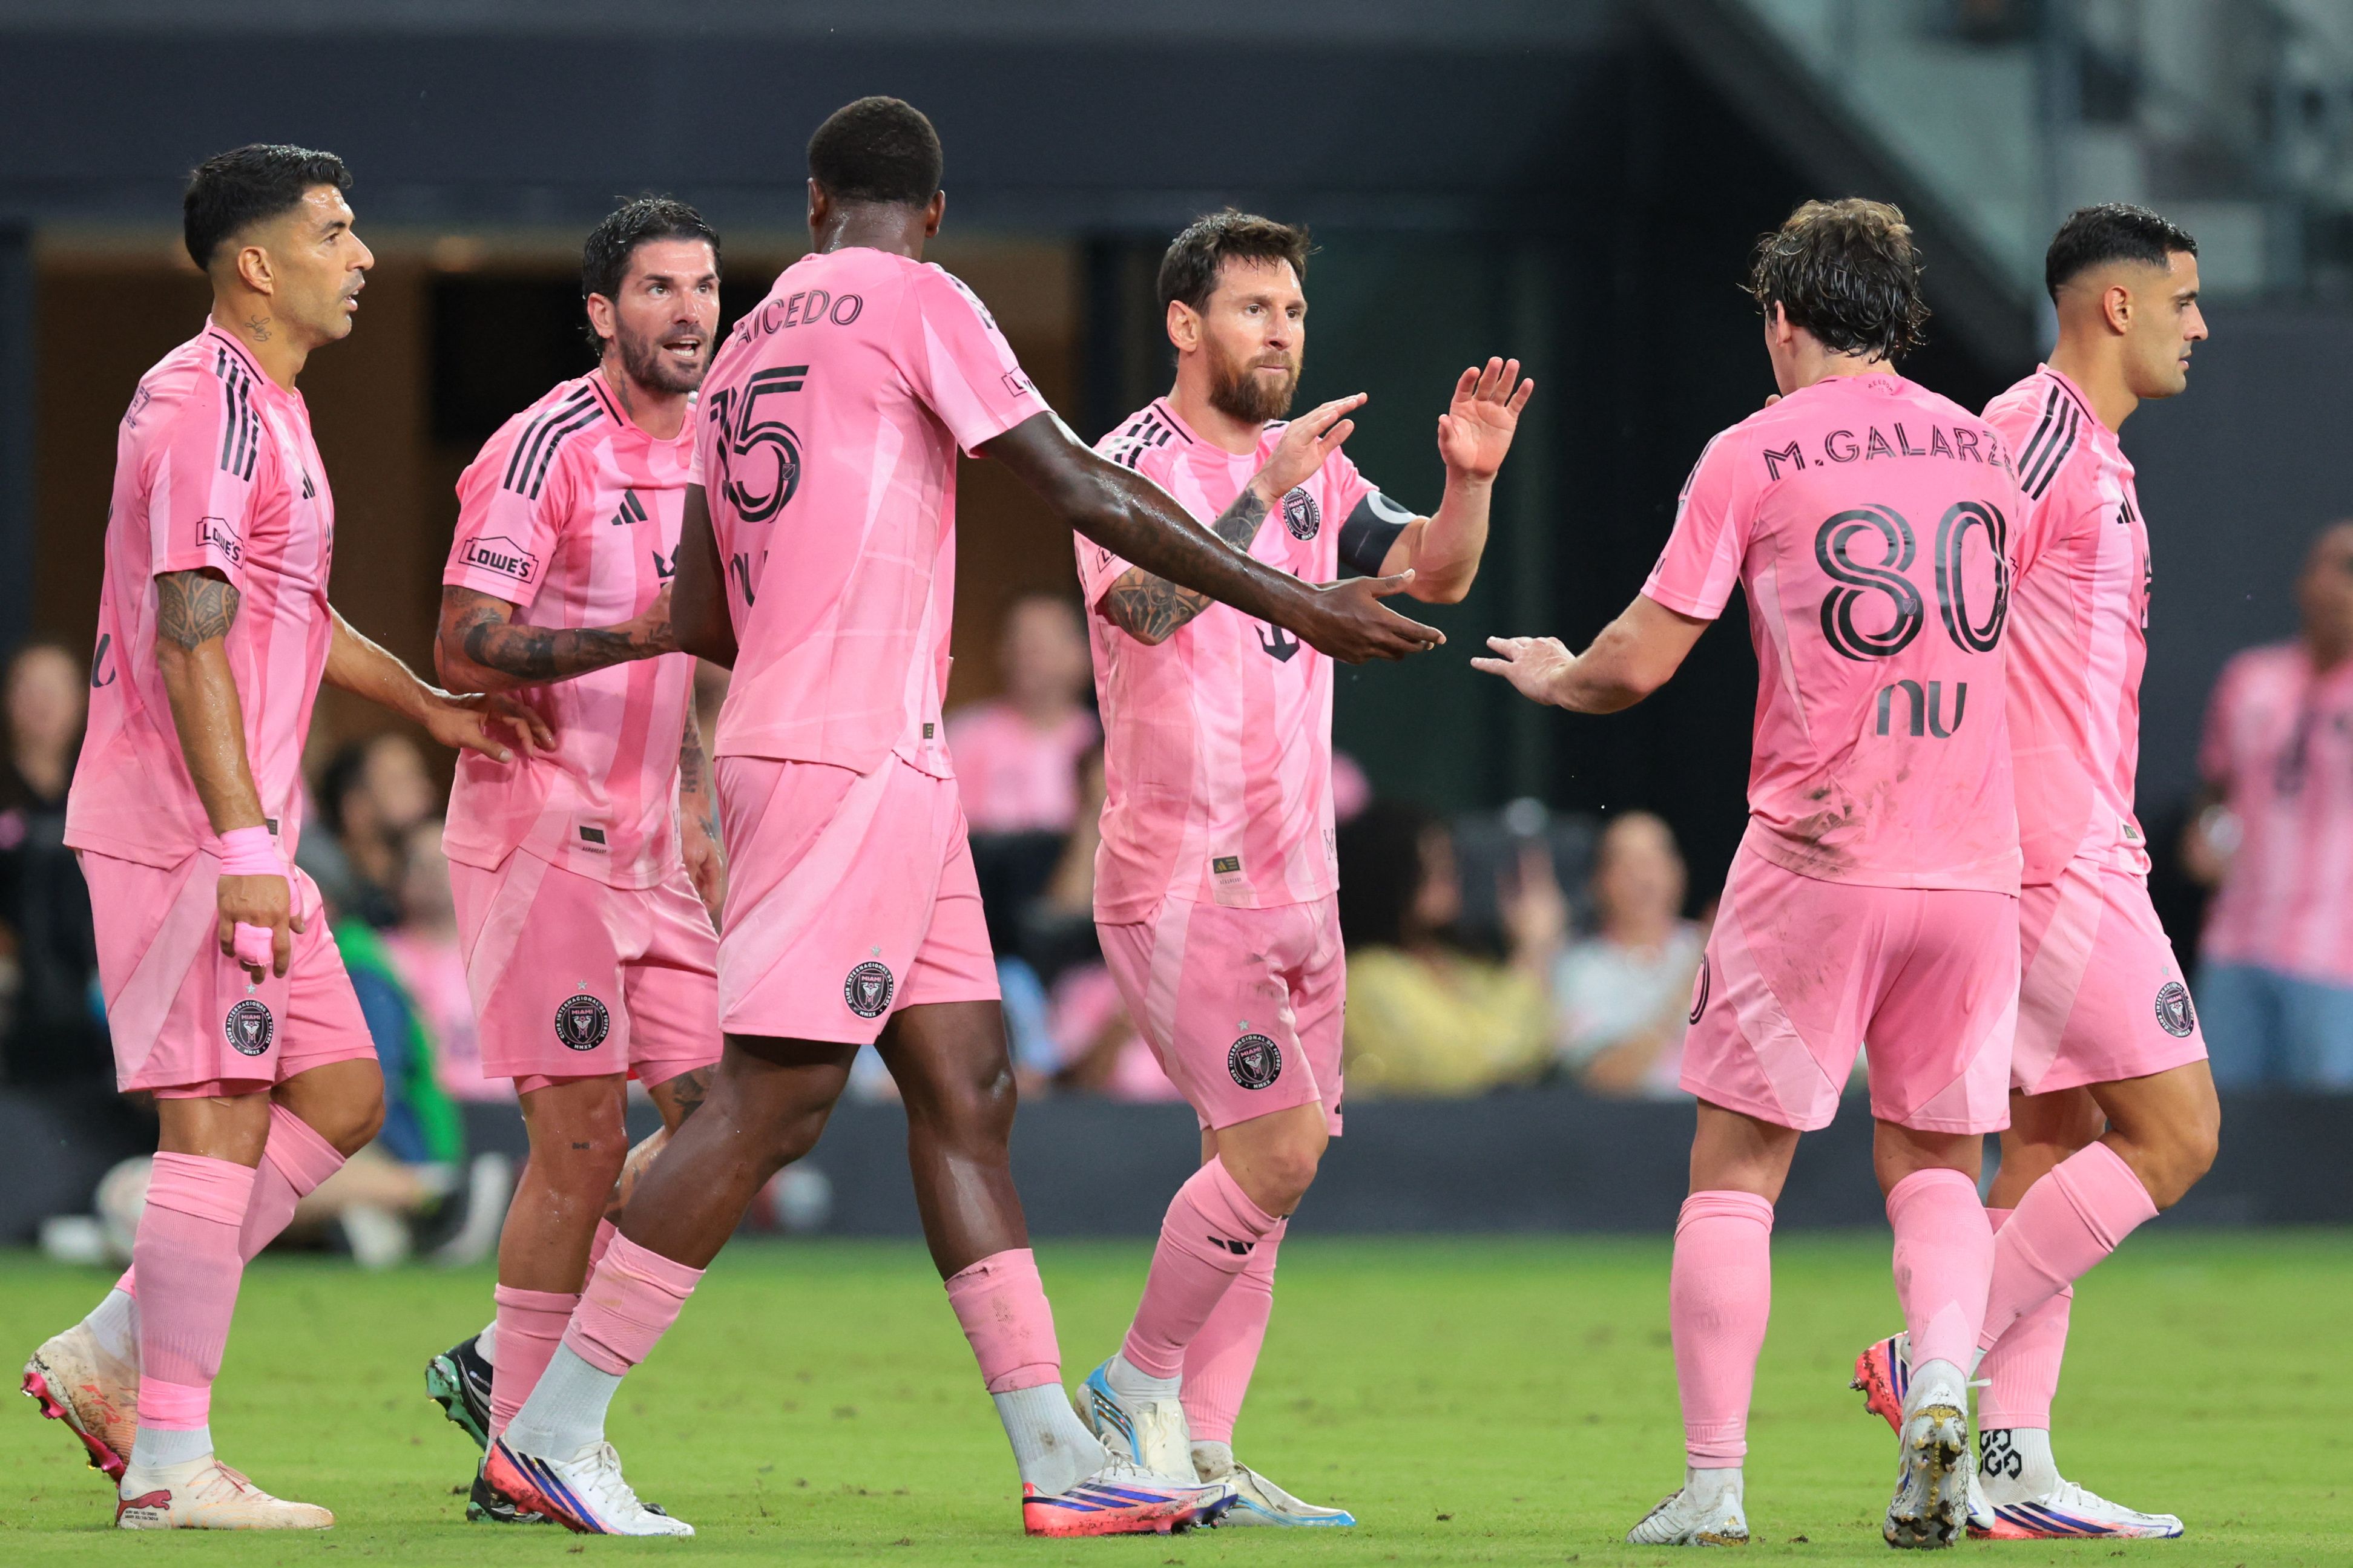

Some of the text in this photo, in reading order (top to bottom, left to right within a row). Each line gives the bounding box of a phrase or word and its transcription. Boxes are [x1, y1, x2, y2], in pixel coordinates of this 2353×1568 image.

[726, 289, 864, 350] AICEDO
[709, 364, 809, 523] 15
[203, 523, 241, 561] LOWE'S
[467, 543, 531, 577] LOWE'S
[1814, 499, 2009, 662] 80
[556, 996, 599, 1021] INTERNACIONAL
[556, 1023, 565, 1038] CLUB
[1240, 1046, 1262, 1057] MIAMI
